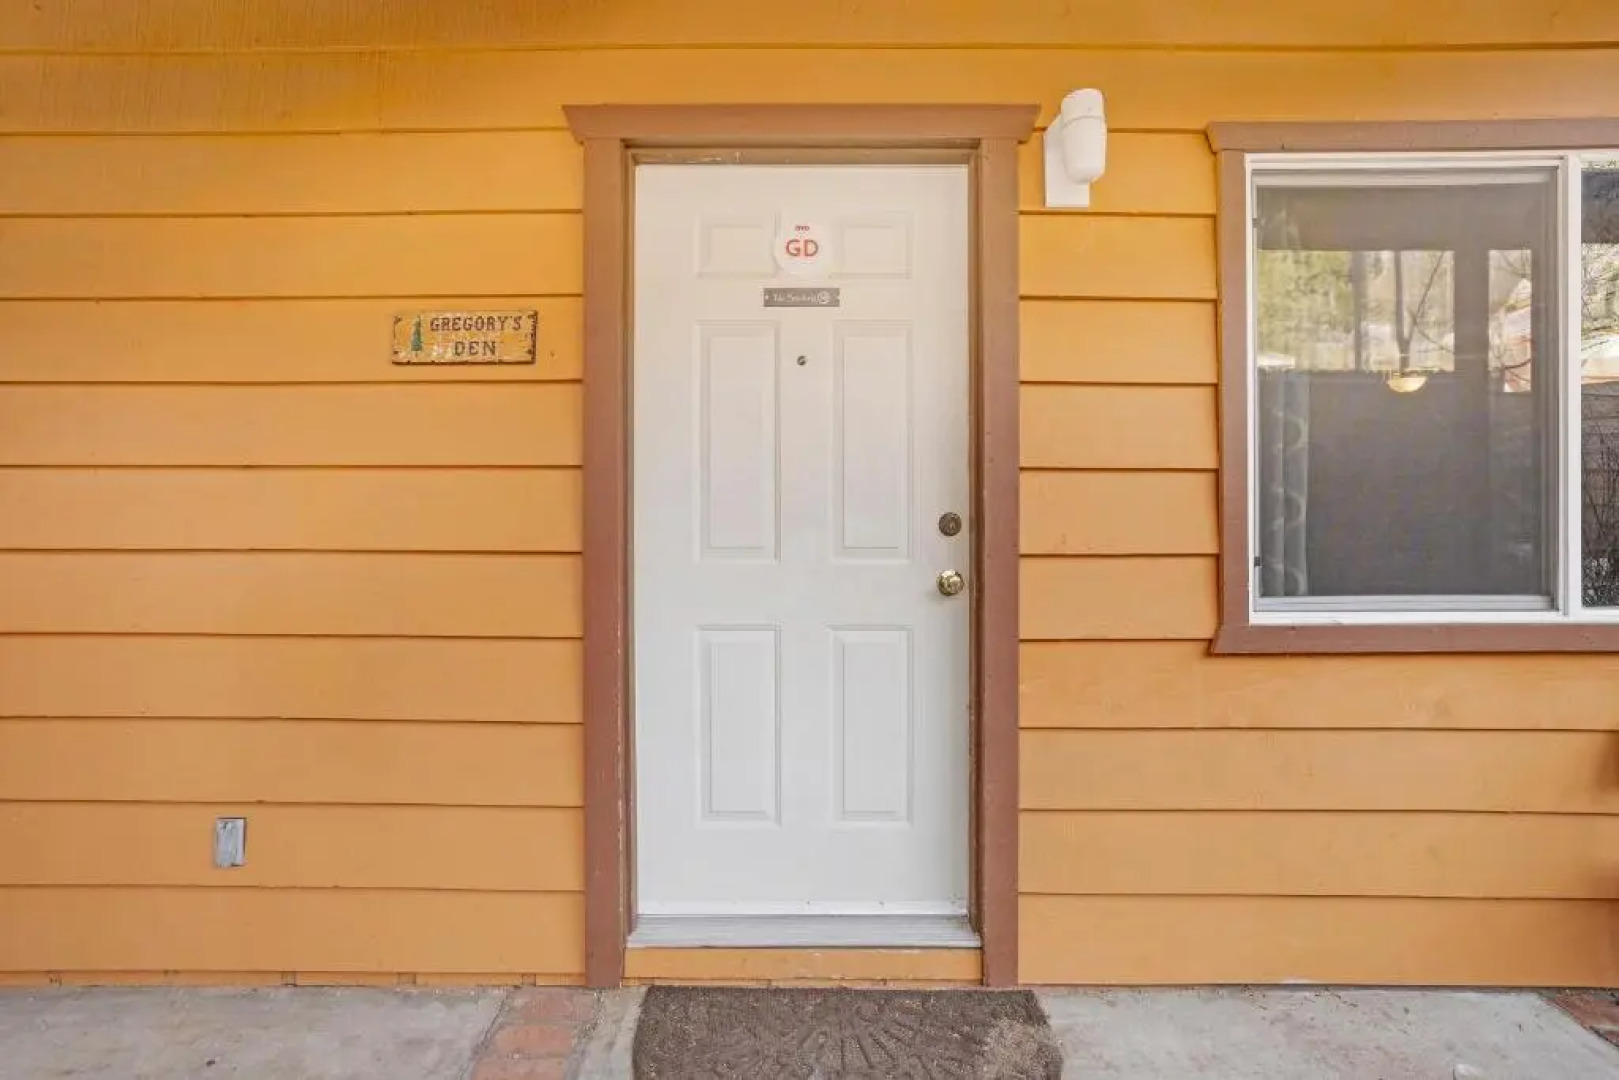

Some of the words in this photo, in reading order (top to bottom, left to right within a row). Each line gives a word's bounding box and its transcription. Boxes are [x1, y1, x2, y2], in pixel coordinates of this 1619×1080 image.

[786, 239, 819, 256] GD
[430, 315, 522, 331] GREGORY'S
[454, 341, 496, 356] DEN
